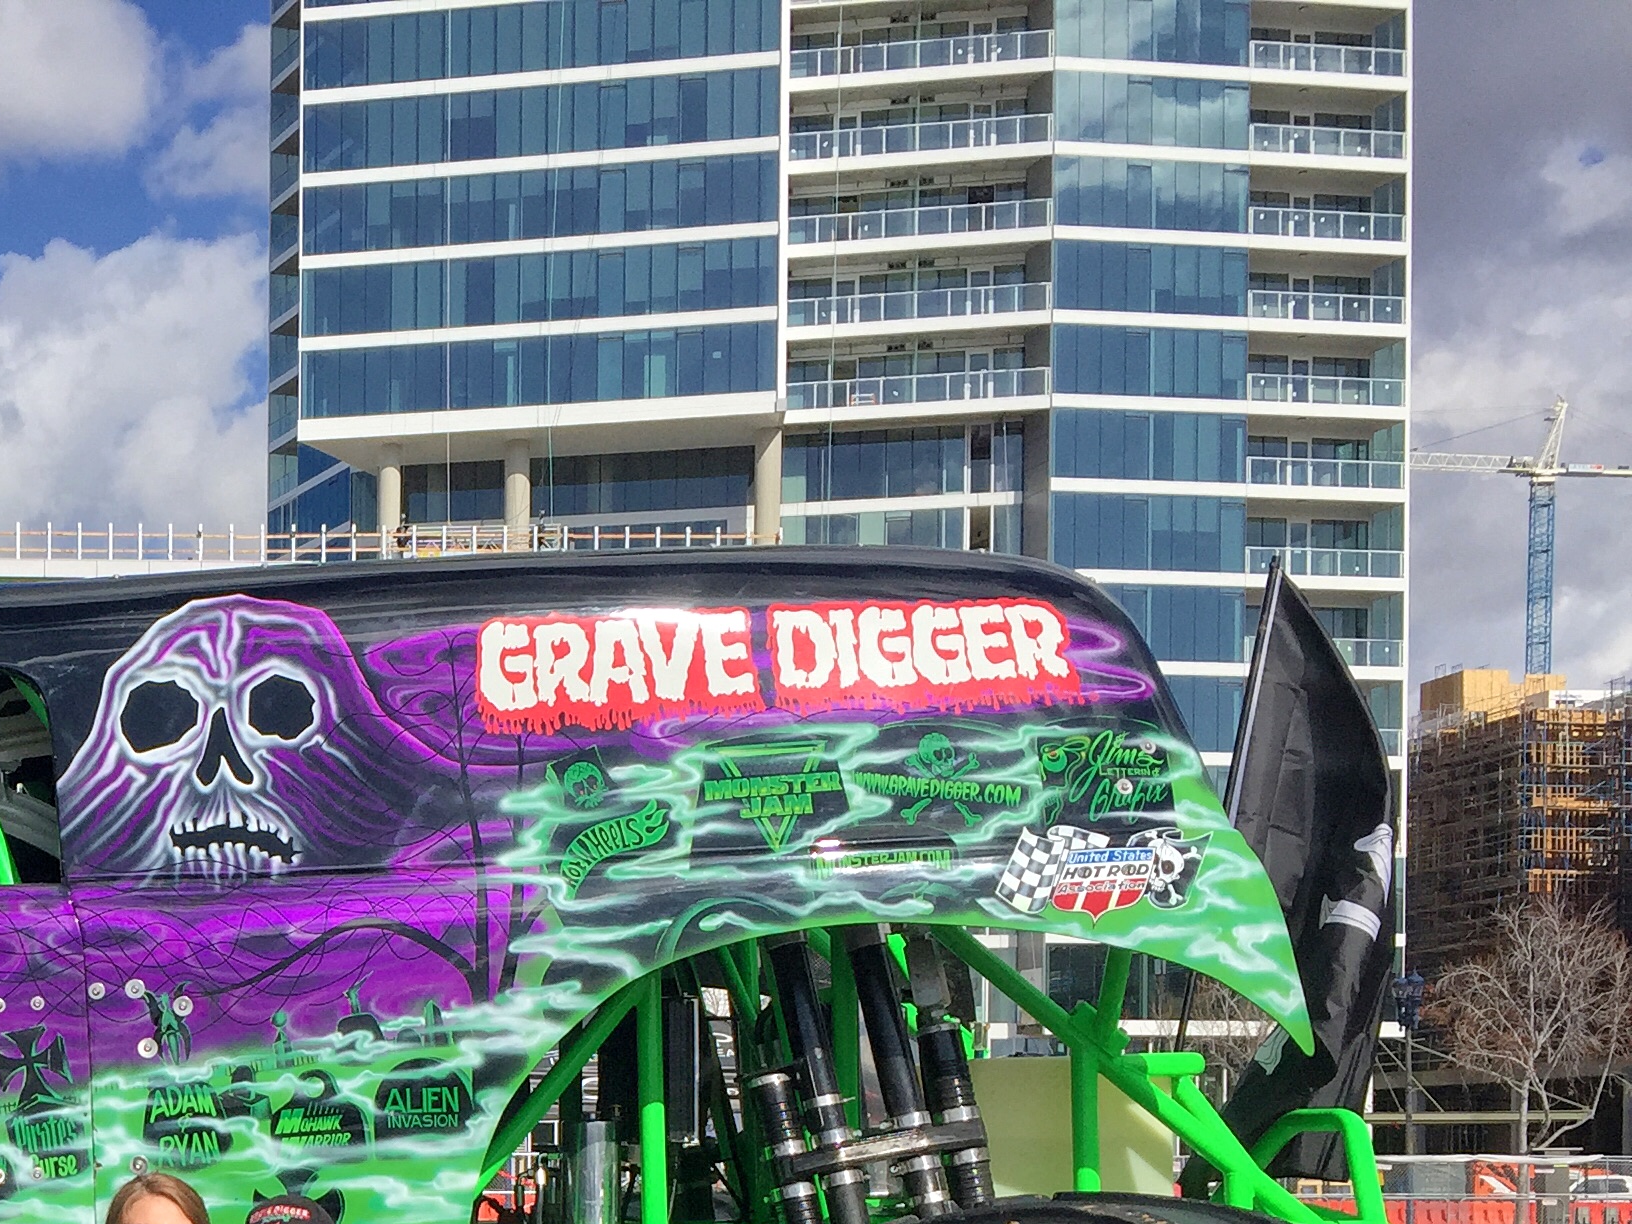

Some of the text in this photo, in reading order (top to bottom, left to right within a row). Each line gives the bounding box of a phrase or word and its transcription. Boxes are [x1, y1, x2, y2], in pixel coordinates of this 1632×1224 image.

[480, 604, 1071, 711] GRAVE DIGGER
[704, 771, 843, 801] MONSTER
[854, 772, 1022, 807] WWW.GRAVEDIGGER.COM
[739, 793, 814, 819] JAM
[1068, 849, 1153, 864] United States
[1062, 863, 1150, 880] HOT ROD
[1057, 881, 1147, 894] Association
[149, 1084, 217, 1123] ADAM
[385, 1086, 460, 1114] ALIEN
[176, 1112, 194, 1133] &
[275, 1108, 344, 1134] MOHAWK
[386, 1113, 459, 1128] INVASION
[158, 1130, 221, 1167] RYAN
[280, 1132, 353, 1155] WARRIOR
[30, 1154, 78, 1179] Curse
